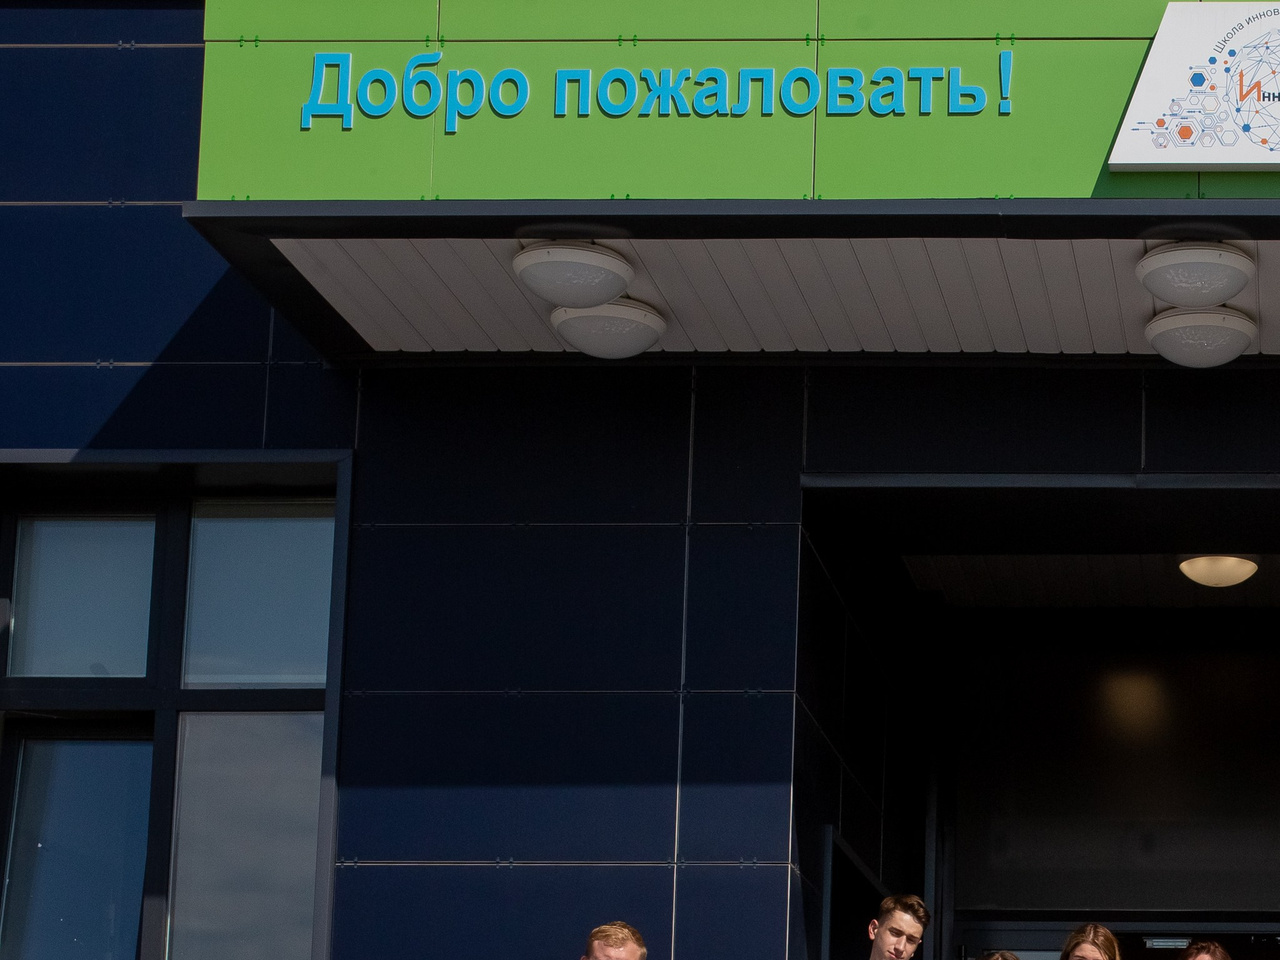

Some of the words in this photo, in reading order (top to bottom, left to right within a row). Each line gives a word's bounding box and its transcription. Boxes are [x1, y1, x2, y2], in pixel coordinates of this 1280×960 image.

[1213, 22, 1245, 53] Школа
[302, 52, 530, 130] Добро
[555, 51, 1014, 116] пожаловать!
